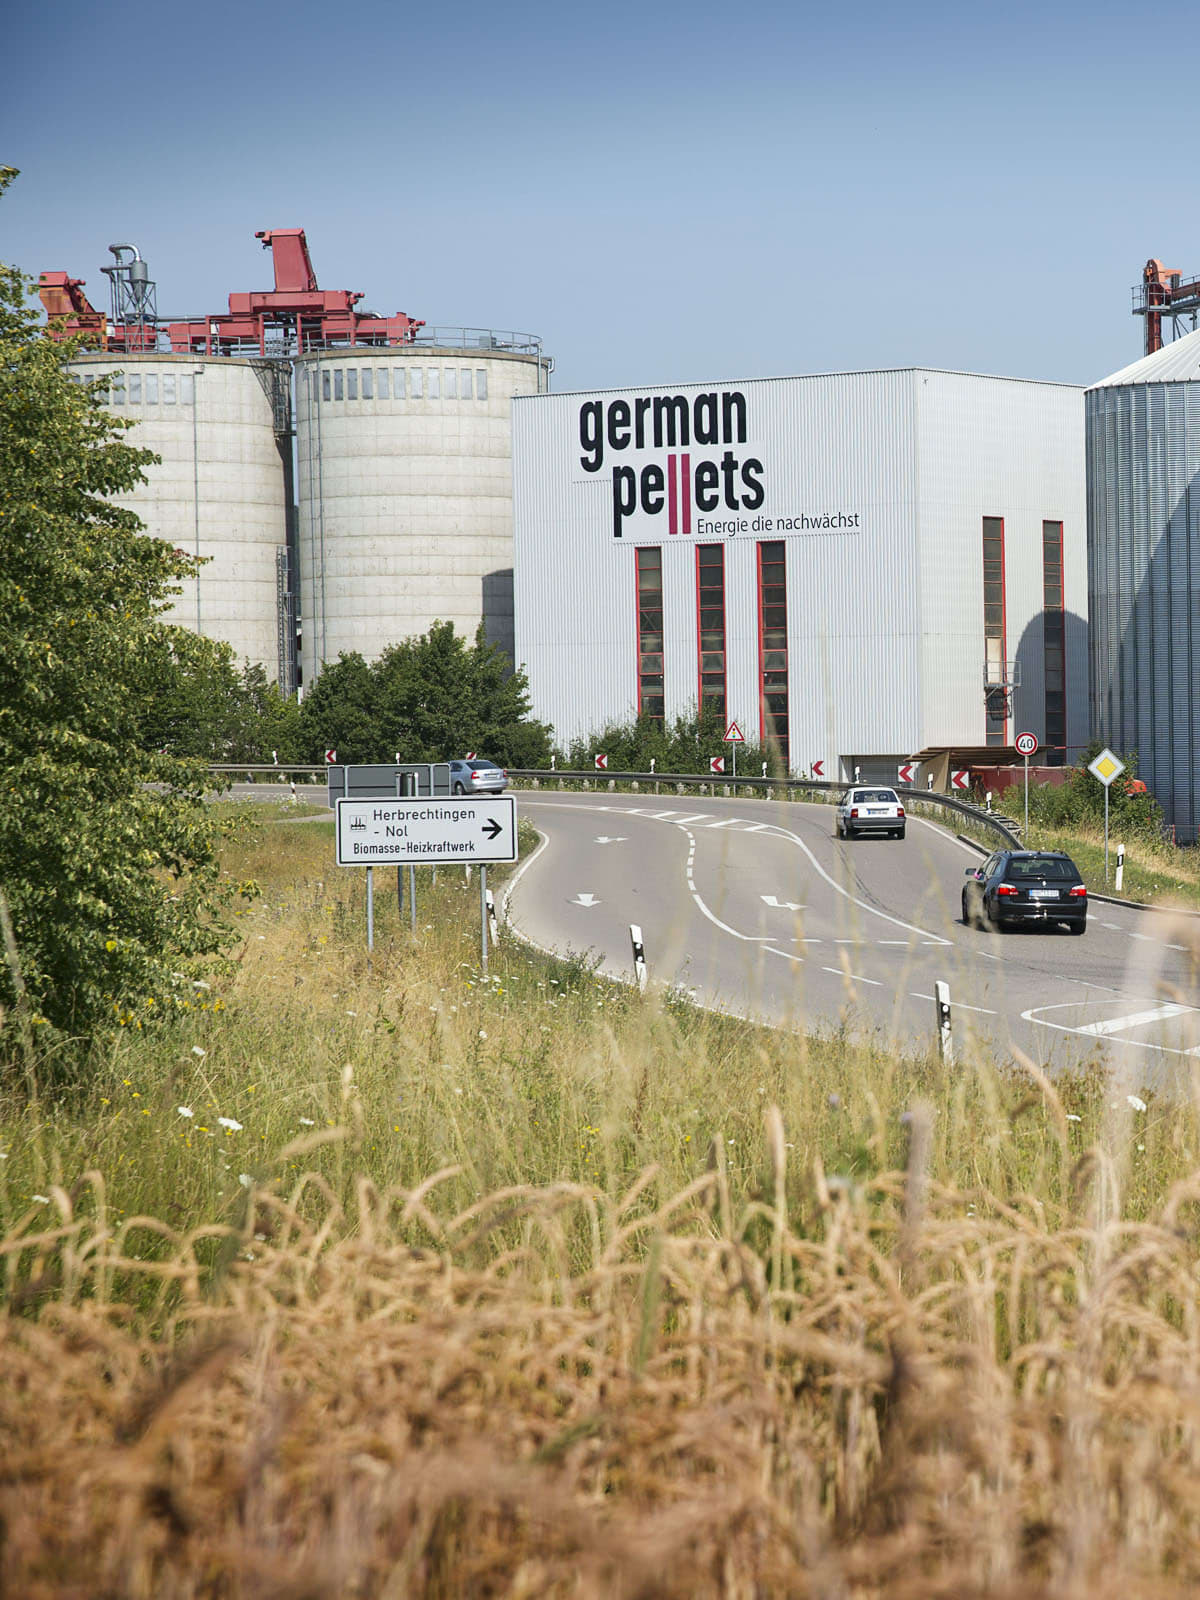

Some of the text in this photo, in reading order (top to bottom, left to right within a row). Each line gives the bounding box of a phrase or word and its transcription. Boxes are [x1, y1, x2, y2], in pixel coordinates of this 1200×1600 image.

[580, 391, 747, 472] german
[613, 451, 765, 537] pellets
[697, 512, 859, 536] Energie die nachwächst
[1020, 739, 1033, 748] 40
[373, 808, 476, 822] Herbrechtingen
[386, 825, 409, 837] Nol
[353, 840, 475, 854] Biomasse-Heizkraftwerk
